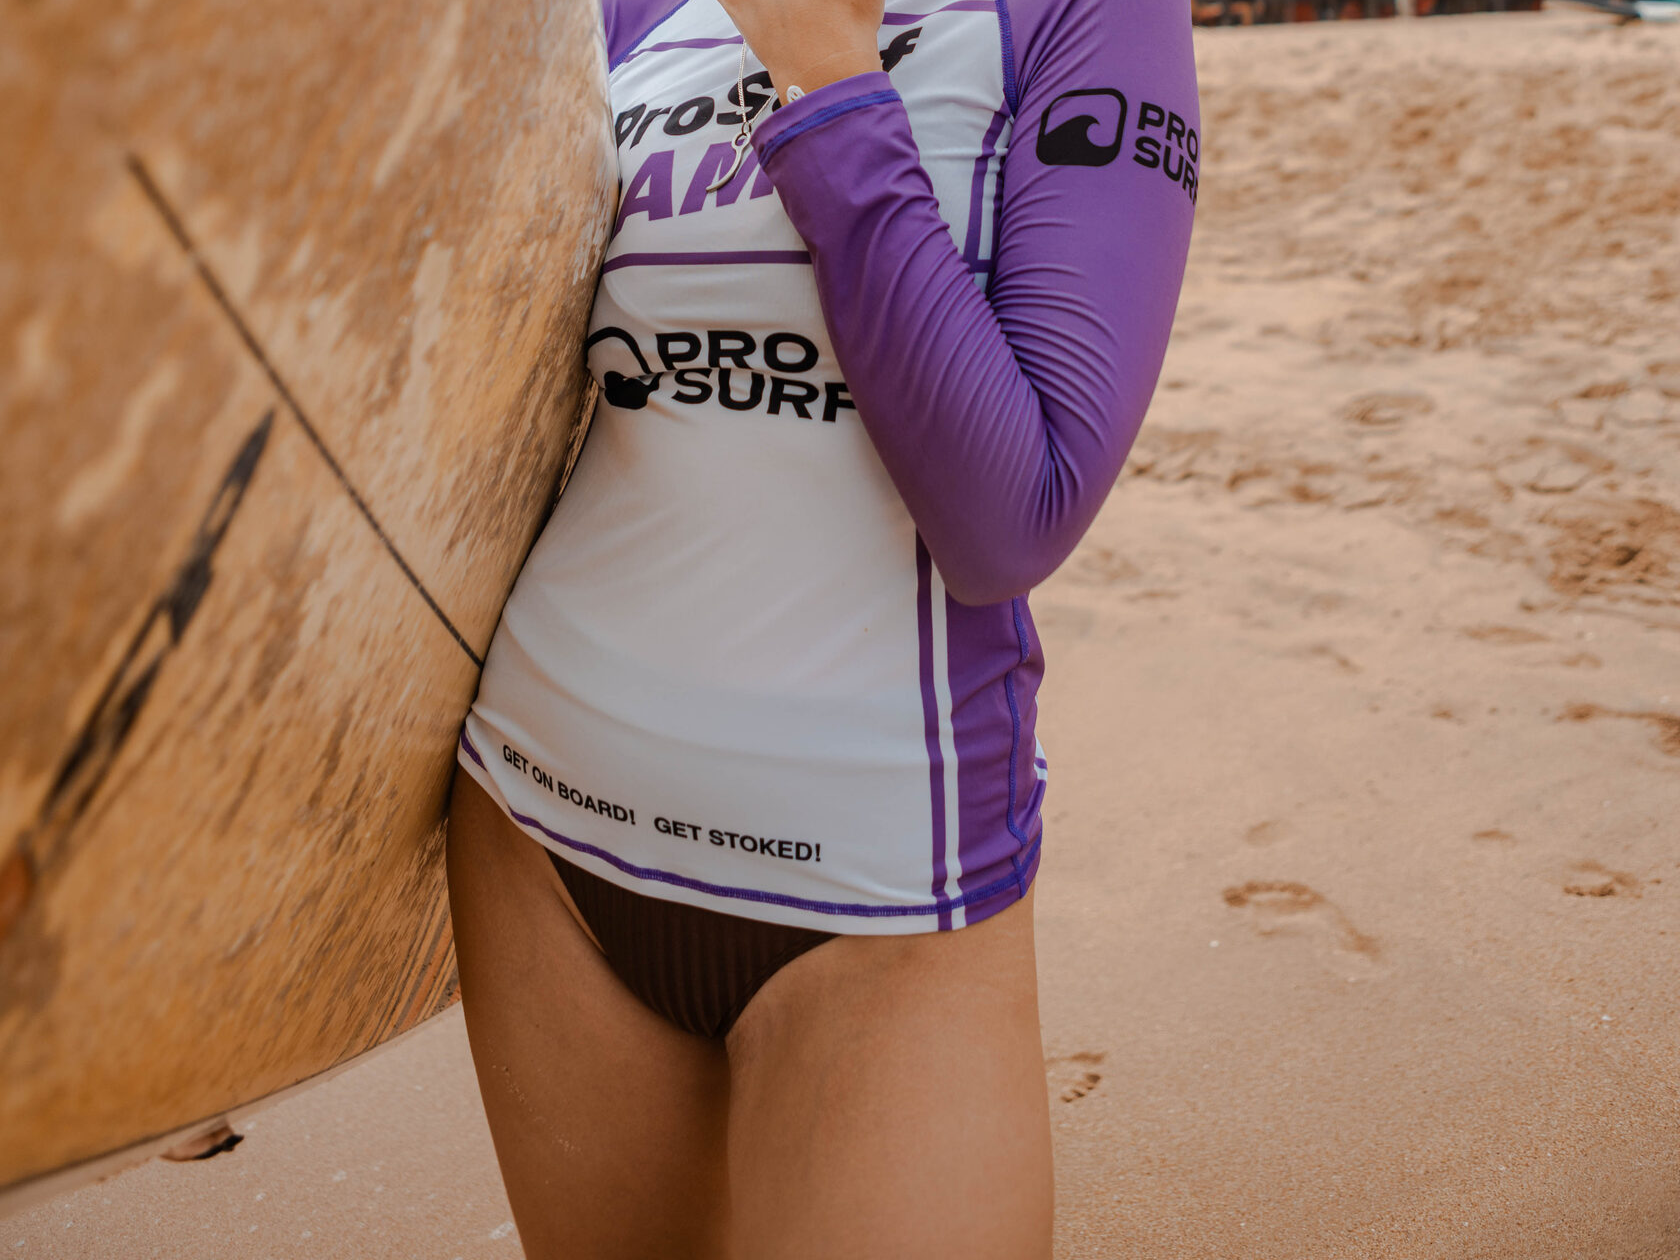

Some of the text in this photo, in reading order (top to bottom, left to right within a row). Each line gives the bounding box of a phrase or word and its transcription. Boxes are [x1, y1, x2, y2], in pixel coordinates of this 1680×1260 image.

[1137, 101, 1198, 164] PRO
[609, 138, 776, 241] AM
[655, 329, 819, 374] PRO
[671, 367, 857, 423] SURF
[502, 744, 821, 862] GET ON BOARD! GET STOKED!
